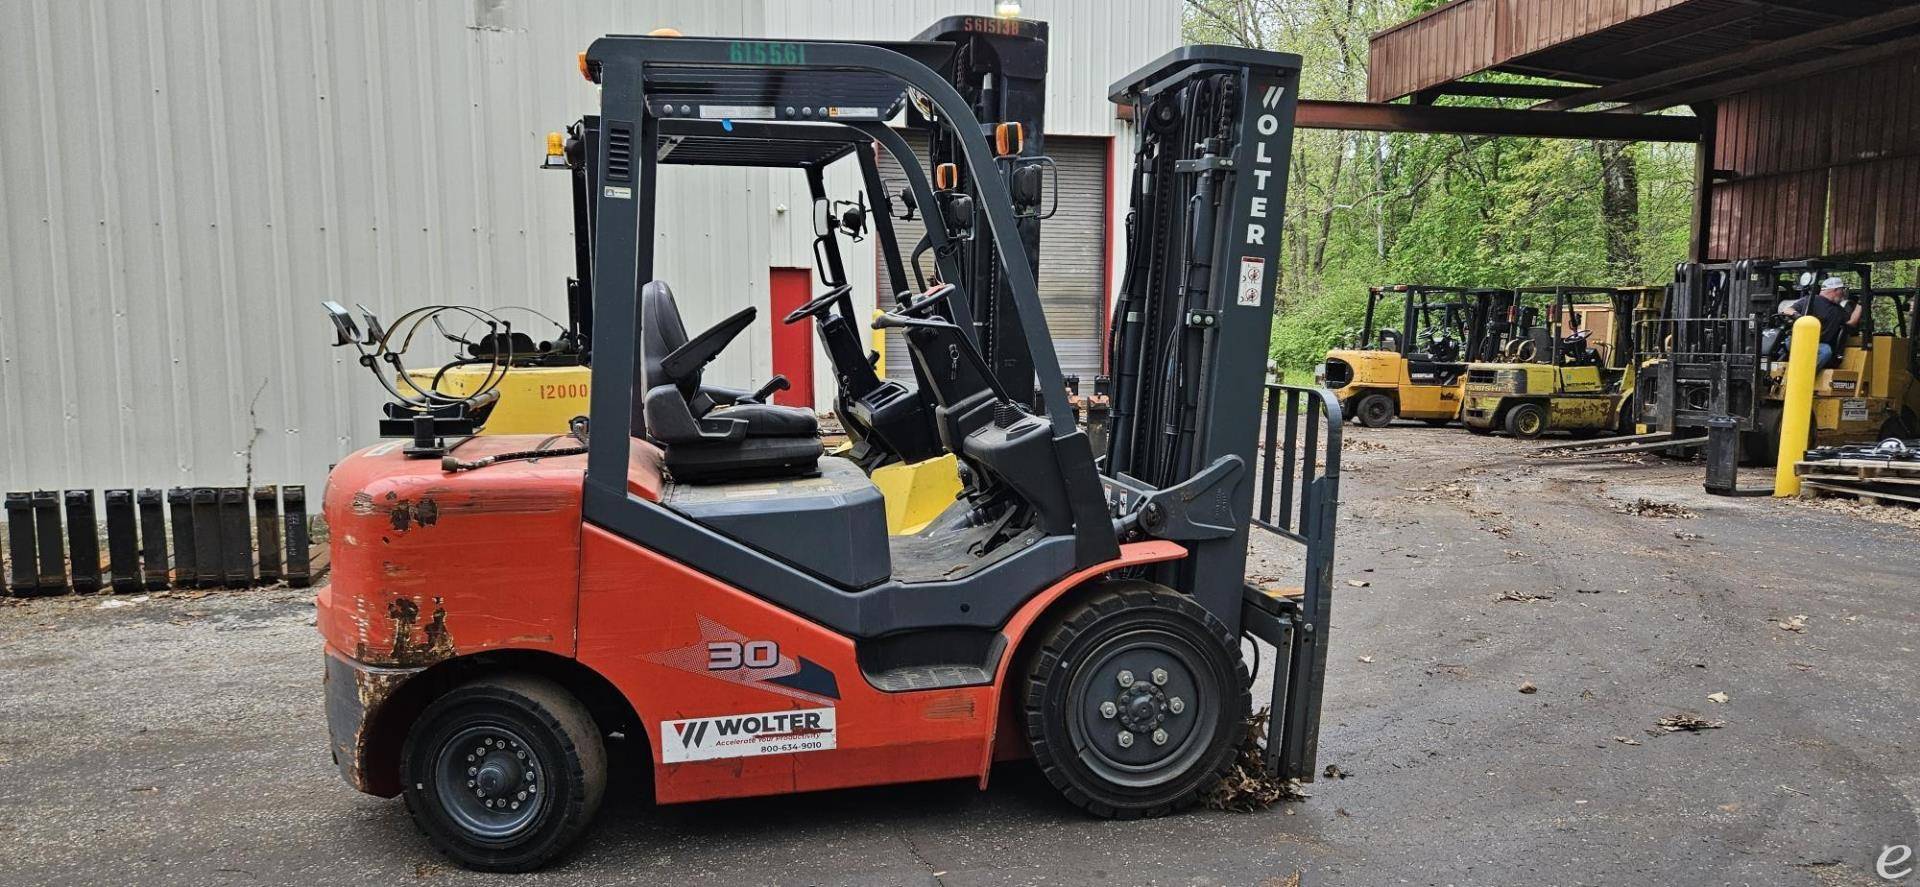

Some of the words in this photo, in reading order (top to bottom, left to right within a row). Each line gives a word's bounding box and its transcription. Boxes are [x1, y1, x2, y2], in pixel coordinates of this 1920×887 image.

[730, 42, 805, 64] 615561
[1246, 86, 1285, 245] WOLTER
[540, 384, 588, 399] 12000
[707, 640, 780, 671] 30
[714, 712, 821, 736] WOLTER
[715, 738, 757, 747] Accelerate
[761, 741, 822, 753] 800-634-9010
